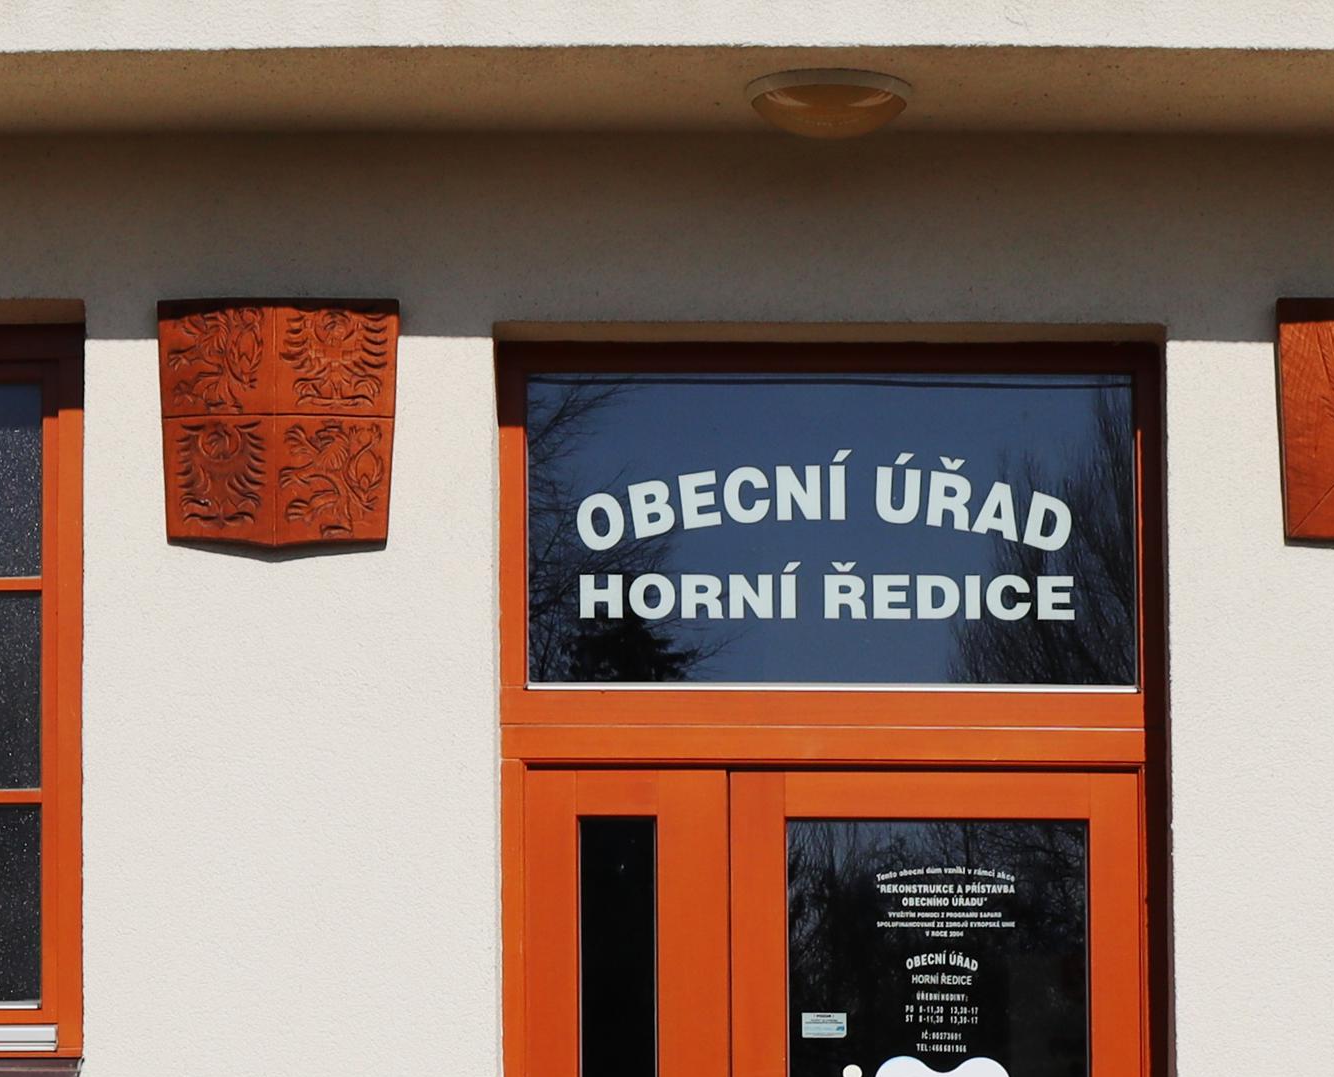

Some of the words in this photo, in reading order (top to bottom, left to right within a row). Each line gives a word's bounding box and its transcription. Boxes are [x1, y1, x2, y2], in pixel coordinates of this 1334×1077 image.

[576, 449, 852, 552] OBECNÍ
[875, 452, 1073, 553] ÚŘAD
[579, 561, 802, 620] HORNÍ
[823, 561, 1076, 621] ŘEDICE
[876, 872, 897, 882] Tento
[899, 867, 924, 876] obecní
[925, 866, 942, 874] dům
[943, 866, 965, 874] vznikl
[973, 866, 995, 877] rámci
[997, 872, 1016, 882] akce
[957, 884, 964, 894] A
[965, 882, 1015, 894] PŘÍSTAVBA
[901, 895, 949, 906] OBECNÍHO
[906, 950, 947, 970] OBECNÍ
[949, 950, 979, 971] ÚŘAD
[911, 972, 939, 984] HORNÍ
[940, 972, 972, 985] ŘEDICE
[905, 1005, 914, 1013] PO
